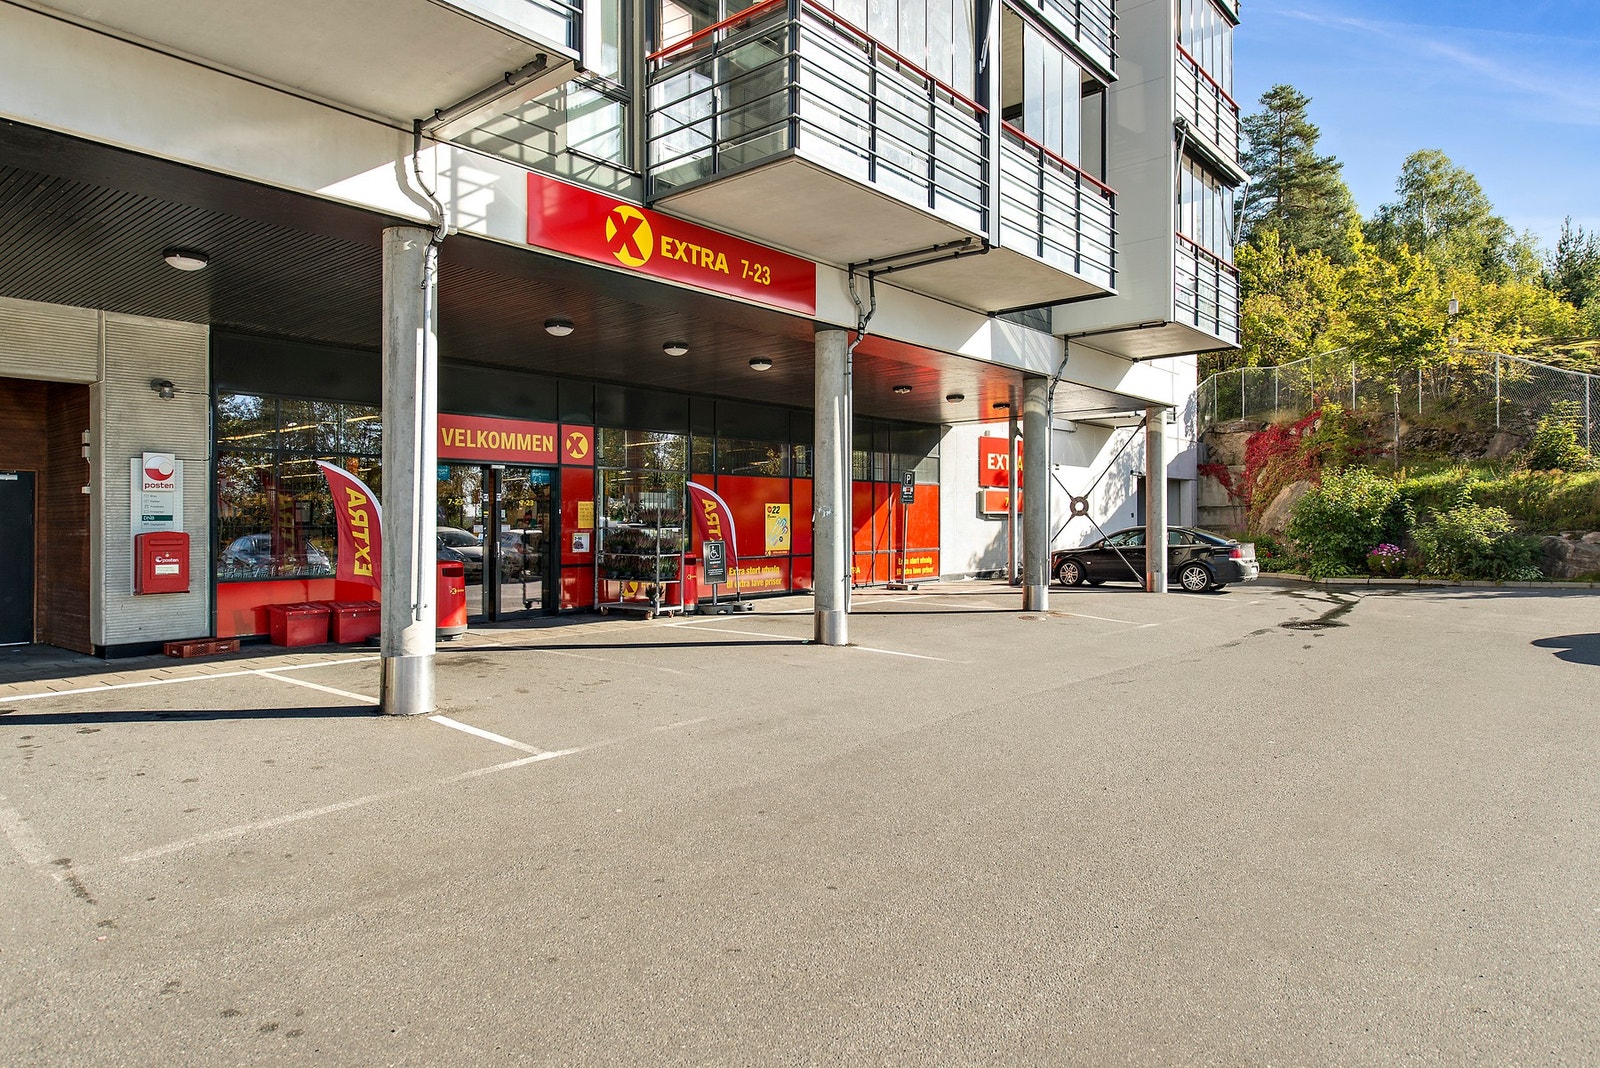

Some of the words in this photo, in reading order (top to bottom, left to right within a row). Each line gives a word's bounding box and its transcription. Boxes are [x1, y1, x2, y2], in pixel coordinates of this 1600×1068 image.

[661, 235, 729, 274] EXTRA
[741, 259, 771, 285] 7-23
[441, 427, 554, 452] VELKOMMEN
[987, 453, 1023, 471] EXTA
[906, 474, 911, 484] P
[144, 481, 174, 490] posten
[772, 505, 780, 514] 22
[728, 567, 745, 576] Exra
[746, 566, 761, 575] stort
[734, 579, 751, 588] etra
[764, 578, 782, 587] priser
